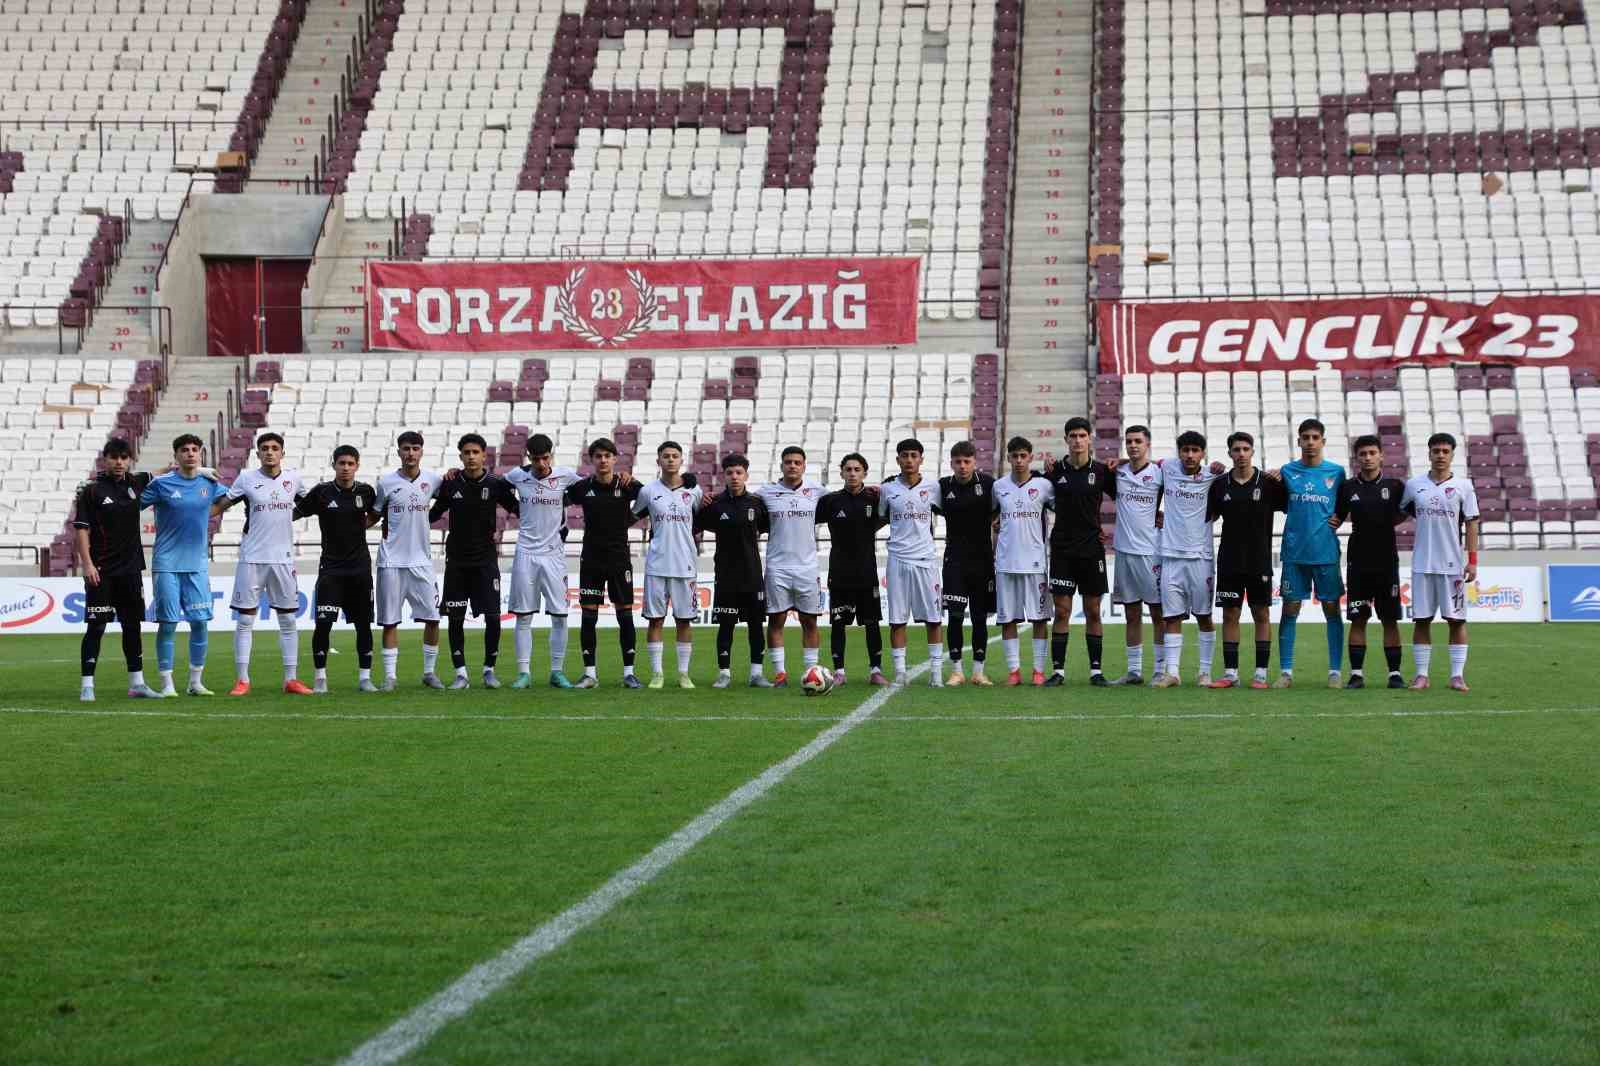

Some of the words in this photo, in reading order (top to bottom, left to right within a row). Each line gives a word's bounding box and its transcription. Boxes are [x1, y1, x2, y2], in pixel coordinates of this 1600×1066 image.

[378, 287, 570, 335] FORZA
[590, 287, 623, 320] 23
[650, 269, 868, 333] ELAZIĞ
[1148, 301, 1478, 369] GENÇLİK
[1479, 311, 1580, 360] 23
